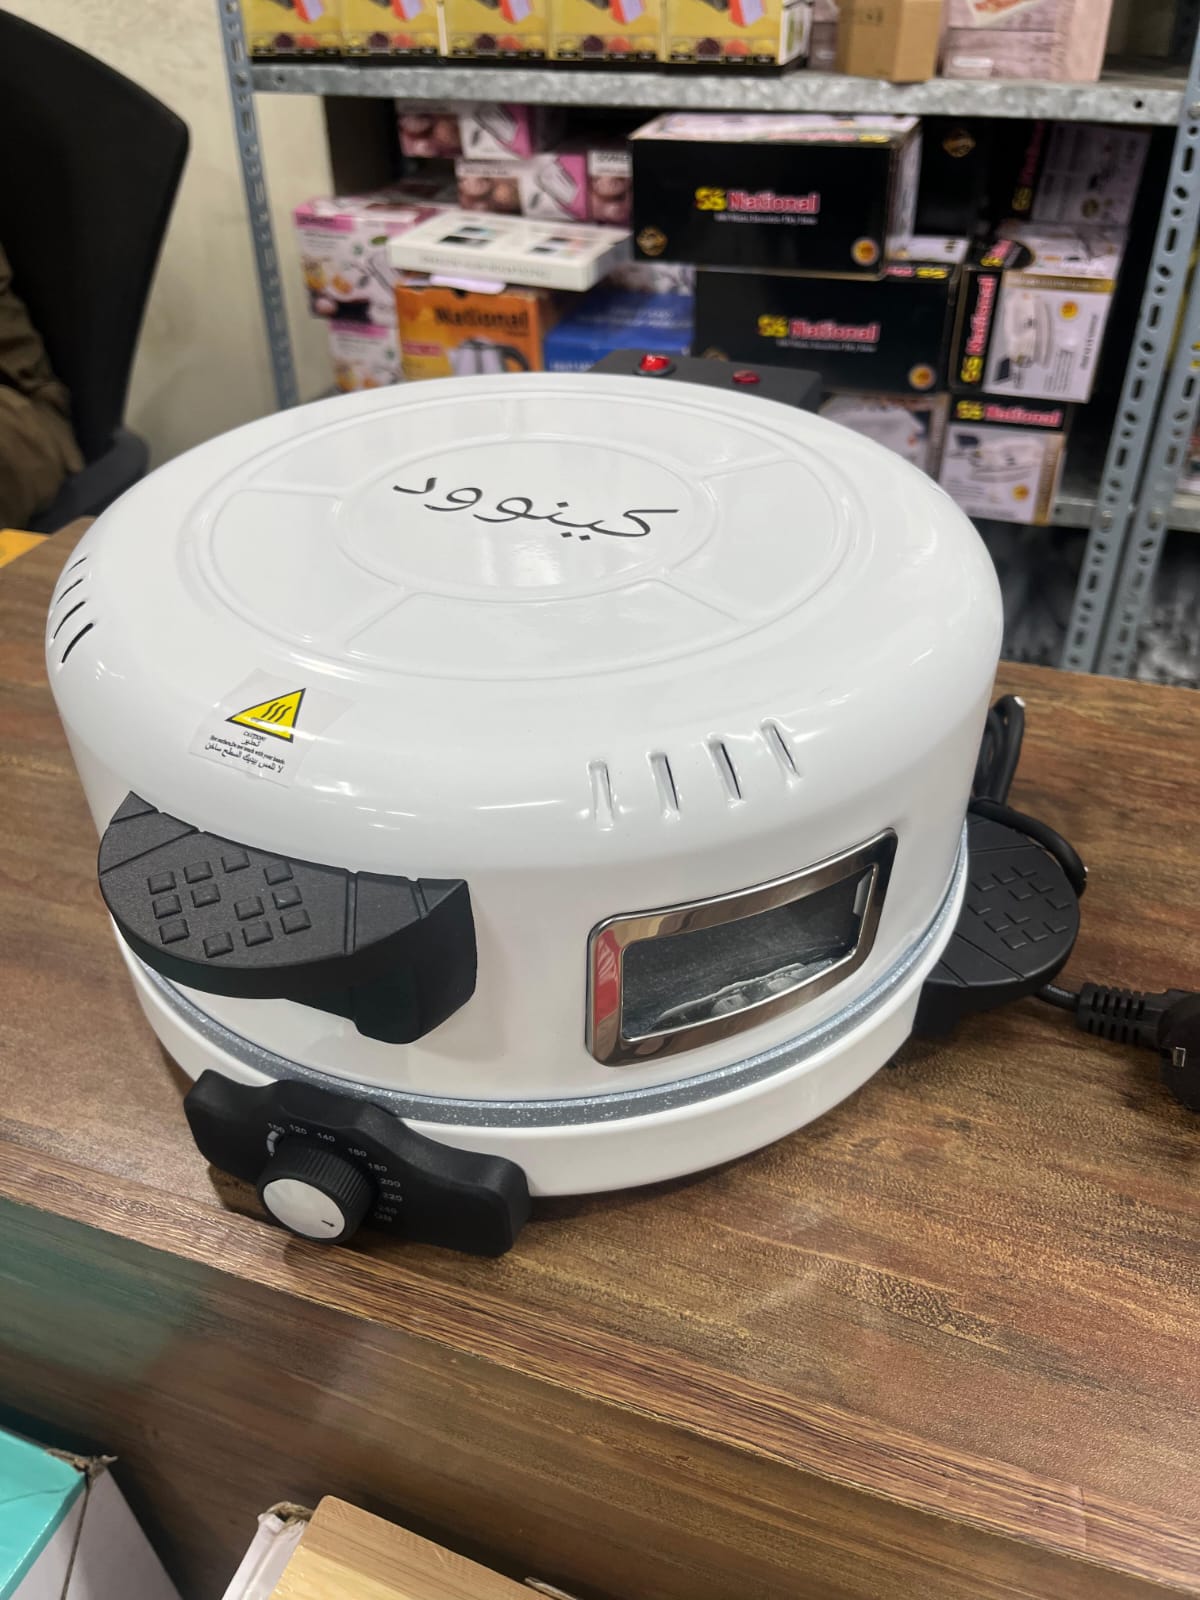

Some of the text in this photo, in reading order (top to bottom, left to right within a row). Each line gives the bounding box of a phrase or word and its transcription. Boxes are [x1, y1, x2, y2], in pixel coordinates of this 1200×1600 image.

[727, 191, 821, 215] National
[788, 319, 880, 343] National
[393, 477, 679, 540] كينوود
[289, 1124, 307, 1135] 120
[317, 1132, 336, 1143] 140
[380, 1178, 401, 1189] 200
